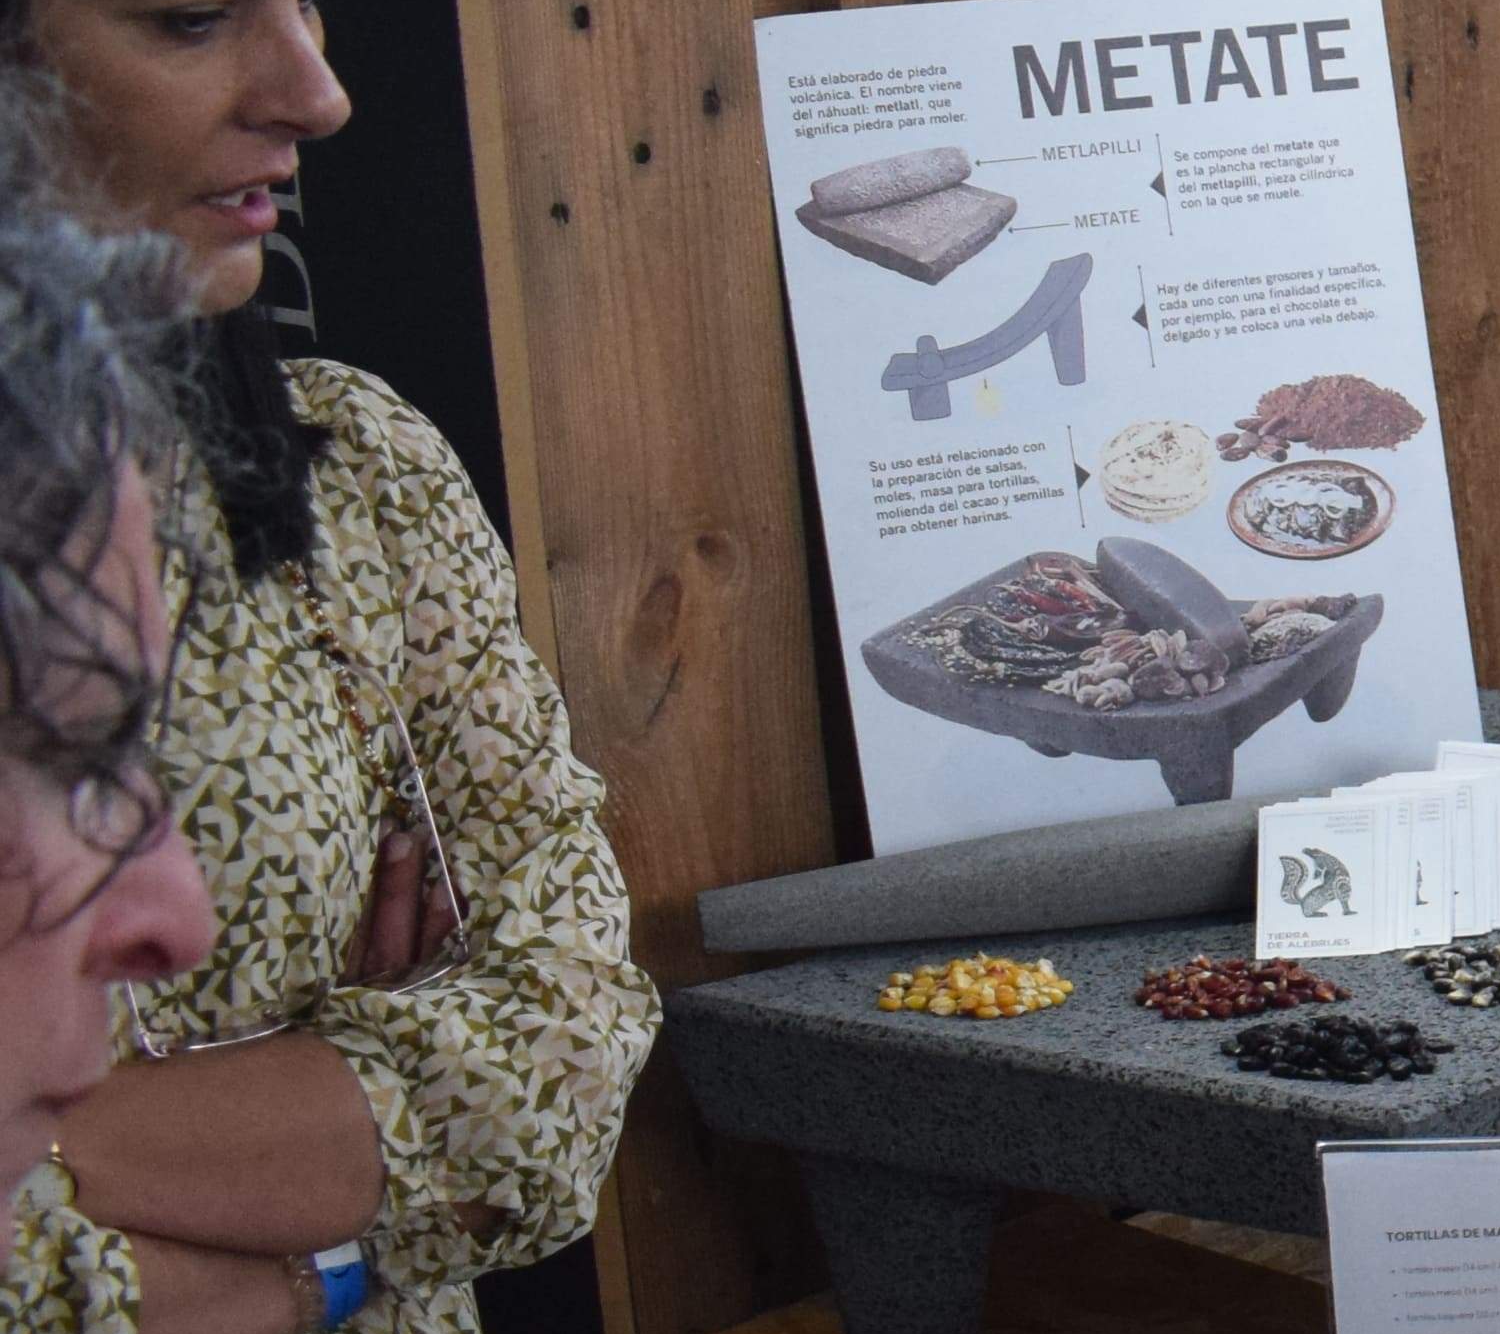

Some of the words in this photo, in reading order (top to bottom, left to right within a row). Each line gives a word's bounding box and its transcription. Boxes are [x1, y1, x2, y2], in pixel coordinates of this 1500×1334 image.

[787, 75, 816, 88] Está
[820, 70, 883, 85] elaborado
[886, 68, 903, 79] de
[907, 65, 947, 79] piedra
[1011, 19, 1360, 119] METATE
[859, 86, 873, 98] El
[876, 84, 925, 96] nombre
[928, 81, 962, 90] viene
[792, 108, 813, 120] del
[927, 99, 951, 110] que
[794, 122, 849, 138] significa
[853, 119, 893, 133] piedra
[897, 117, 926, 129] para
[1041, 138, 1142, 163] METLAPILLI
[1173, 150, 1189, 161] Se
[1193, 147, 1247, 159] compone
[1251, 143, 1270, 154] del
[1273, 140, 1314, 151] metate
[1318, 138, 1340, 149] que
[1175, 168, 1190, 177] es
[1193, 165, 1205, 175] la
[1208, 161, 1256, 176] plancha
[1259, 154, 1324, 168] rectangular
[1327, 154, 1336, 164] y
[1178, 182, 1197, 193] del
[1264, 174, 1296, 186] pieza
[1180, 199, 1202, 208] con
[1205, 196, 1217, 205] la
[1220, 195, 1243, 206] que
[1246, 193, 1260, 202] se
[1073, 208, 1141, 228] METATE
[1156, 284, 1180, 295] Hay
[1183, 282, 1199, 292] de
[1202, 276, 1262, 290] diferentes
[1265, 270, 1314, 285] grosores
[1316, 270, 1324, 279] y
[1158, 299, 1188, 311] cada
[1191, 297, 1214, 307] uno
[1217, 294, 1239, 304] con
[1242, 291, 1265, 301] una
[1268, 283, 1320, 297] finalidad
[1160, 317, 1180, 328] por
[1239, 307, 1266, 319] para
[1269, 303, 1281, 314] el
[1284, 298, 1340, 312] chocolate
[1343, 297, 1357, 305] es
[1162, 328, 1211, 342] delgado
[1212, 329, 1221, 338] y
[1224, 326, 1237, 335] se
[1241, 321, 1279, 333] coloca
[1283, 318, 1306, 328] una
[1308, 313, 1333, 324] vela
[868, 460, 887, 472] Su
[890, 459, 913, 469] uso
[916, 453, 943, 466] está
[946, 444, 1019, 461] relacionado
[1022, 442, 1046, 452] con
[871, 478, 884, 487] la
[887, 468, 962, 488] preparación
[965, 465, 981, 475] de
[920, 486, 954, 497] masa
[957, 482, 985, 495] para
[875, 503, 935, 519] molienda
[938, 499, 959, 512] del
[962, 497, 999, 508] cacao
[1001, 496, 1009, 506] y
[1012, 487, 1065, 502] semillas
[878, 525, 907, 538] para
[910, 518, 958, 531] obtener
[1386, 1229, 1459, 1243] TORTILLAS
[1462, 1228, 1480, 1239] DE
